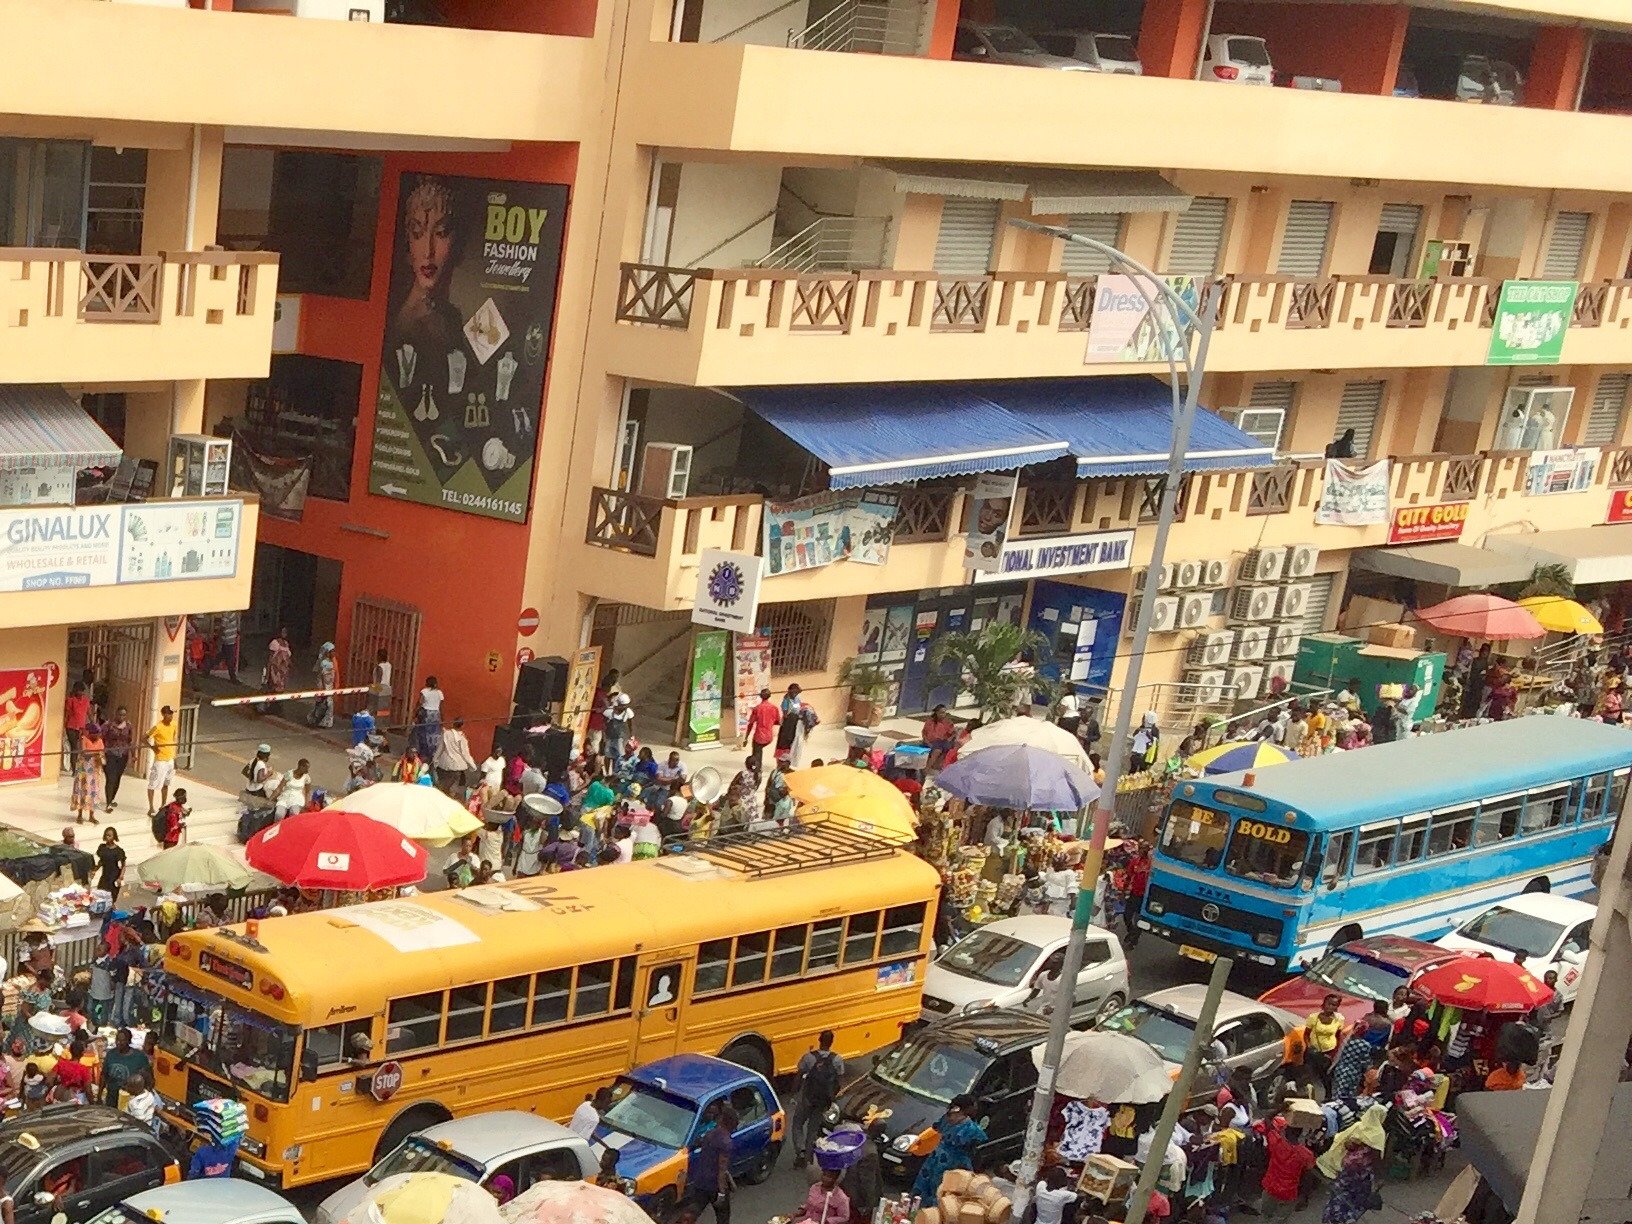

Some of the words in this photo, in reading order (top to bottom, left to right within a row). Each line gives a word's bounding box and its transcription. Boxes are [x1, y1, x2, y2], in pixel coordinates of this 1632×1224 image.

[485, 205, 548, 245] BOY
[484, 242, 538, 262] FASHION
[1097, 287, 1146, 313] Dress
[1397, 506, 1430, 527] CITY
[1432, 503, 1469, 523] GOLD
[7, 513, 112, 545] GINALUX
[7, 556, 64, 571] WHOLESALE
[66, 556, 74, 566] &
[76, 554, 108, 566] RETAIL
[1037, 542, 1099, 569] INVESTMENT
[1098, 539, 1128, 564] BANK
[25, 578, 48, 589] SHOP
[1190, 806, 1215, 825] BE
[1237, 819, 1291, 844] BOLD
[375, 1072, 401, 1090] STOP
